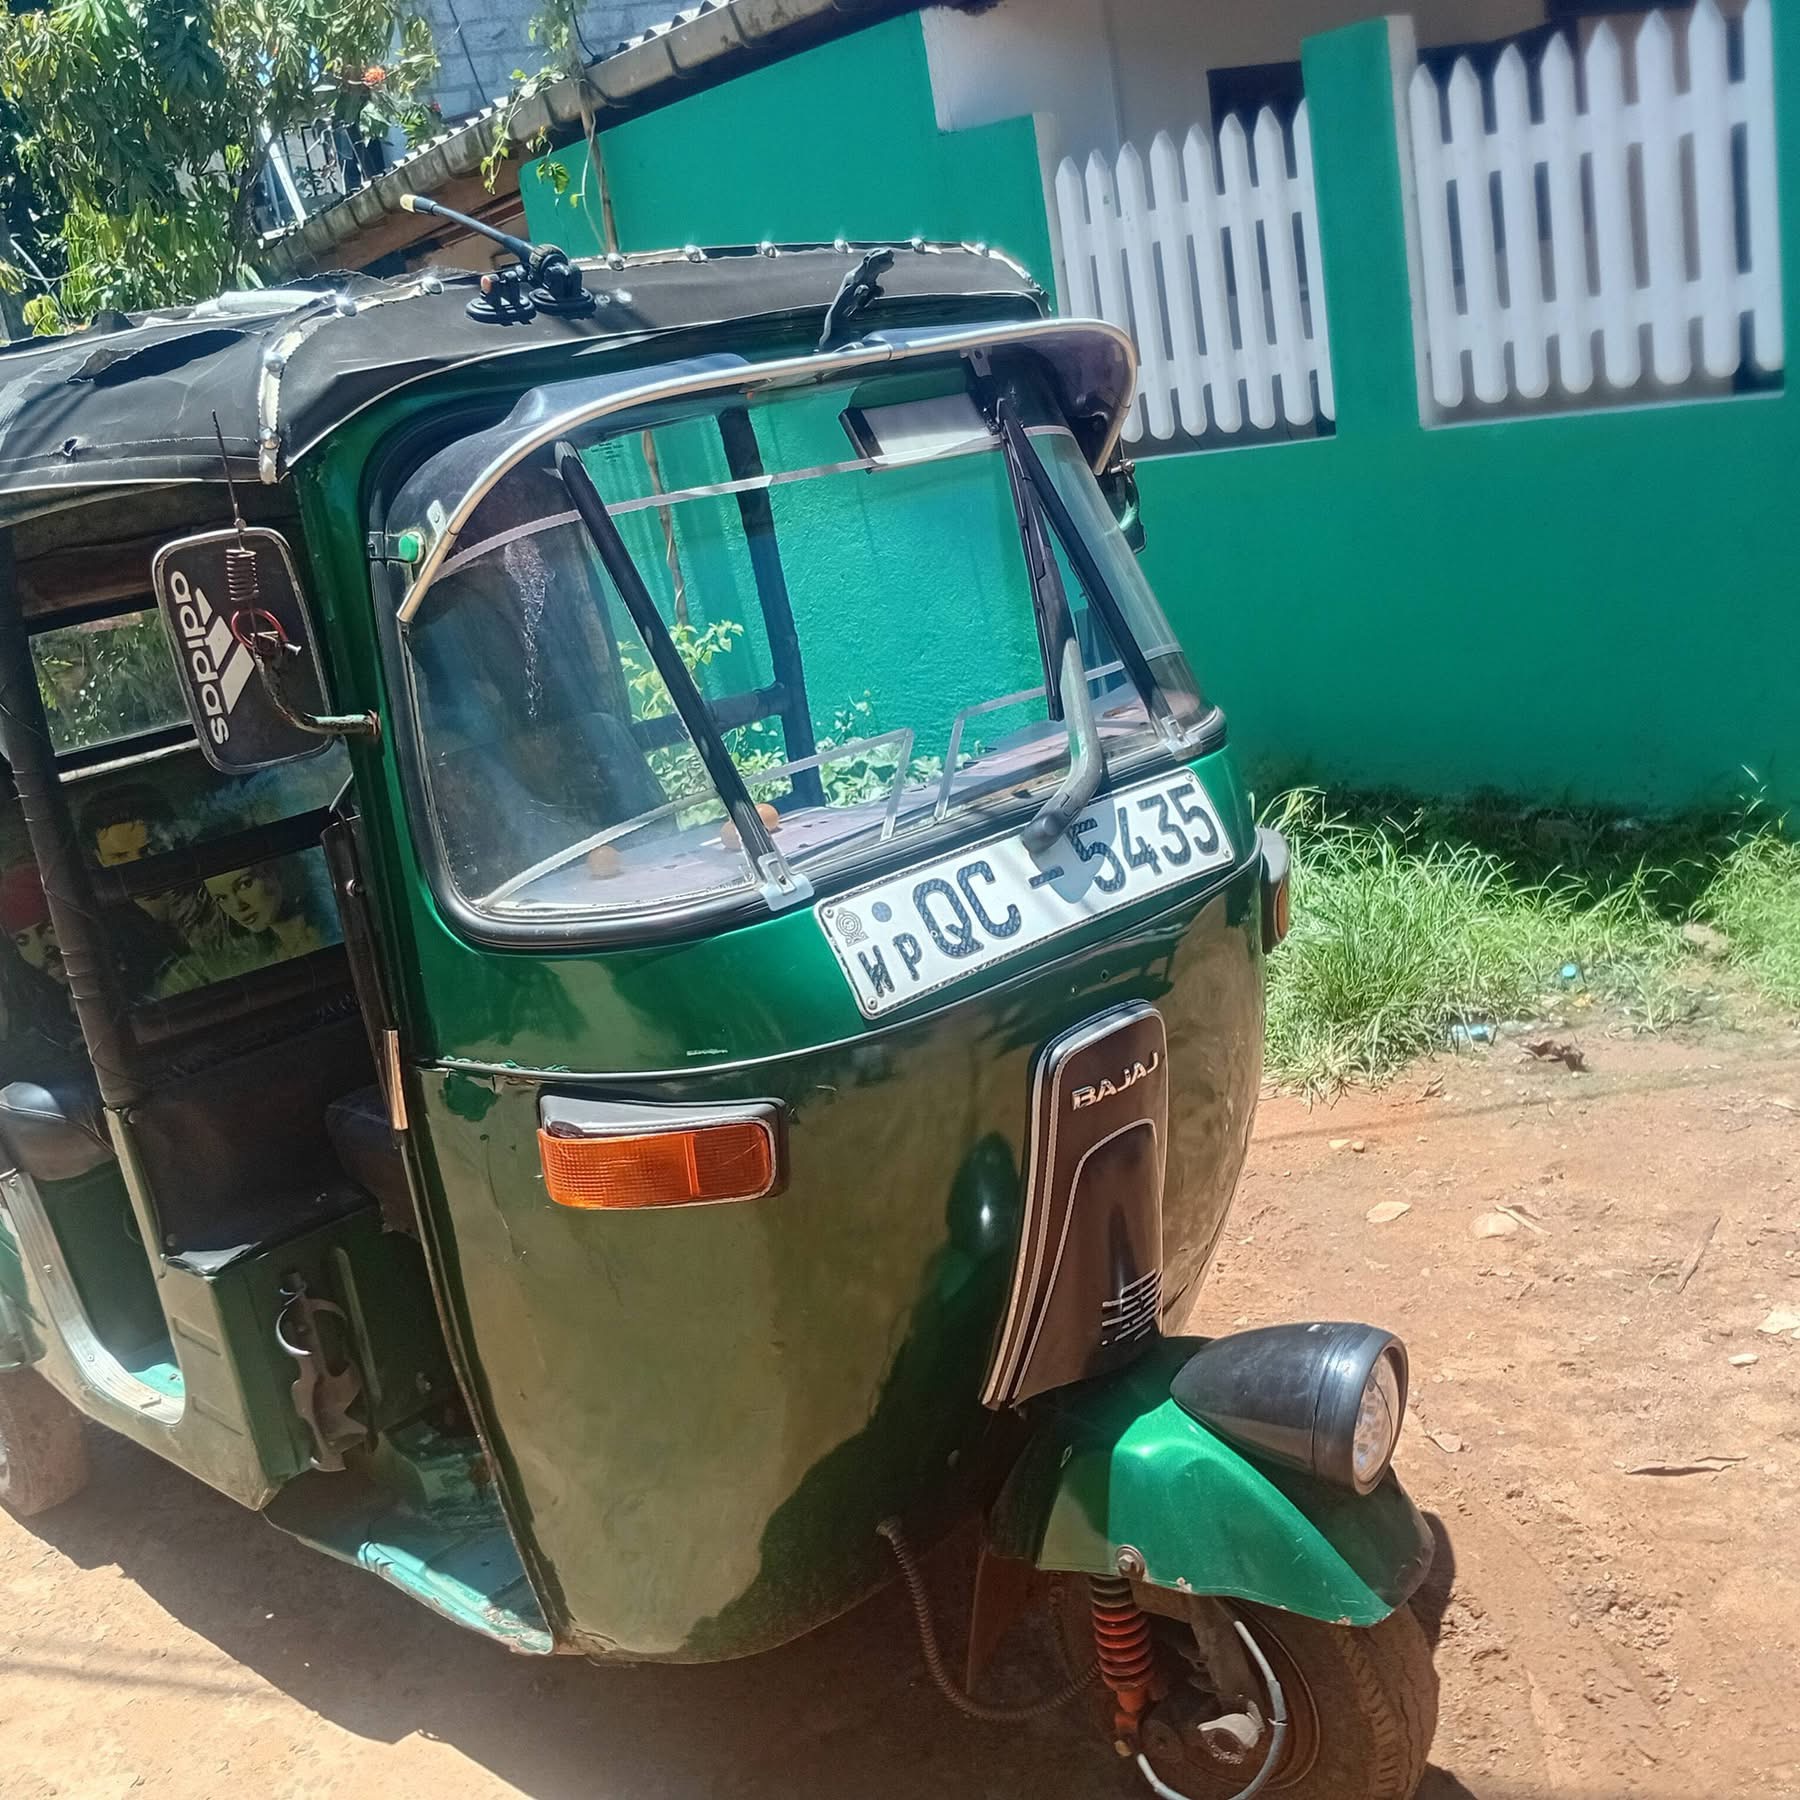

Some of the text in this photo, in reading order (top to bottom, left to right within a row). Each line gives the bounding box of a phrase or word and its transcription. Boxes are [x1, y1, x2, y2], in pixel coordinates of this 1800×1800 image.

[170, 571, 230, 745] adidas
[858, 932, 923, 998] WP
[1072, 1052, 1159, 1111] BAJAJ
